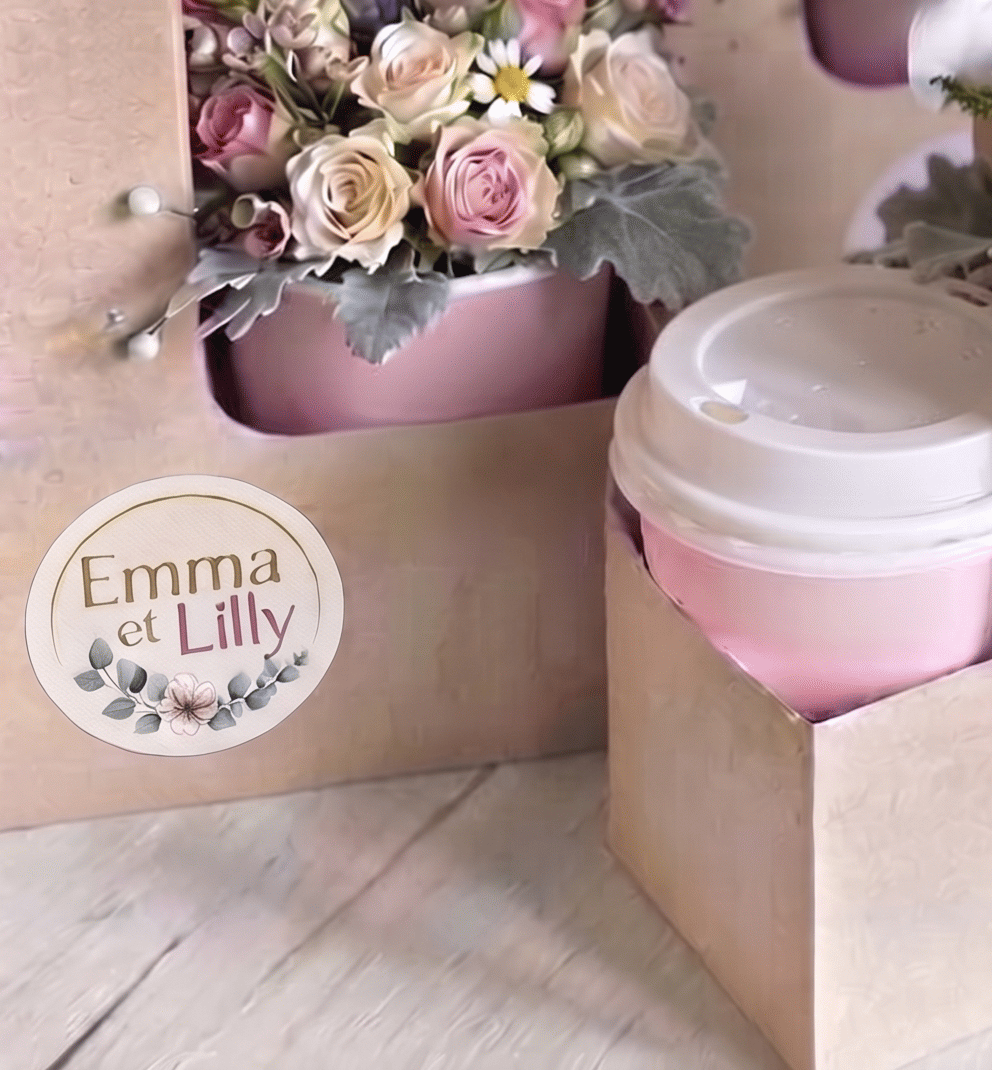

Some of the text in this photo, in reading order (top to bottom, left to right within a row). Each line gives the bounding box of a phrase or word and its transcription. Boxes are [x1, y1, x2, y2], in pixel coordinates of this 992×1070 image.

[81, 548, 281, 608] Emma
[117, 591, 295, 660] et Lilly
